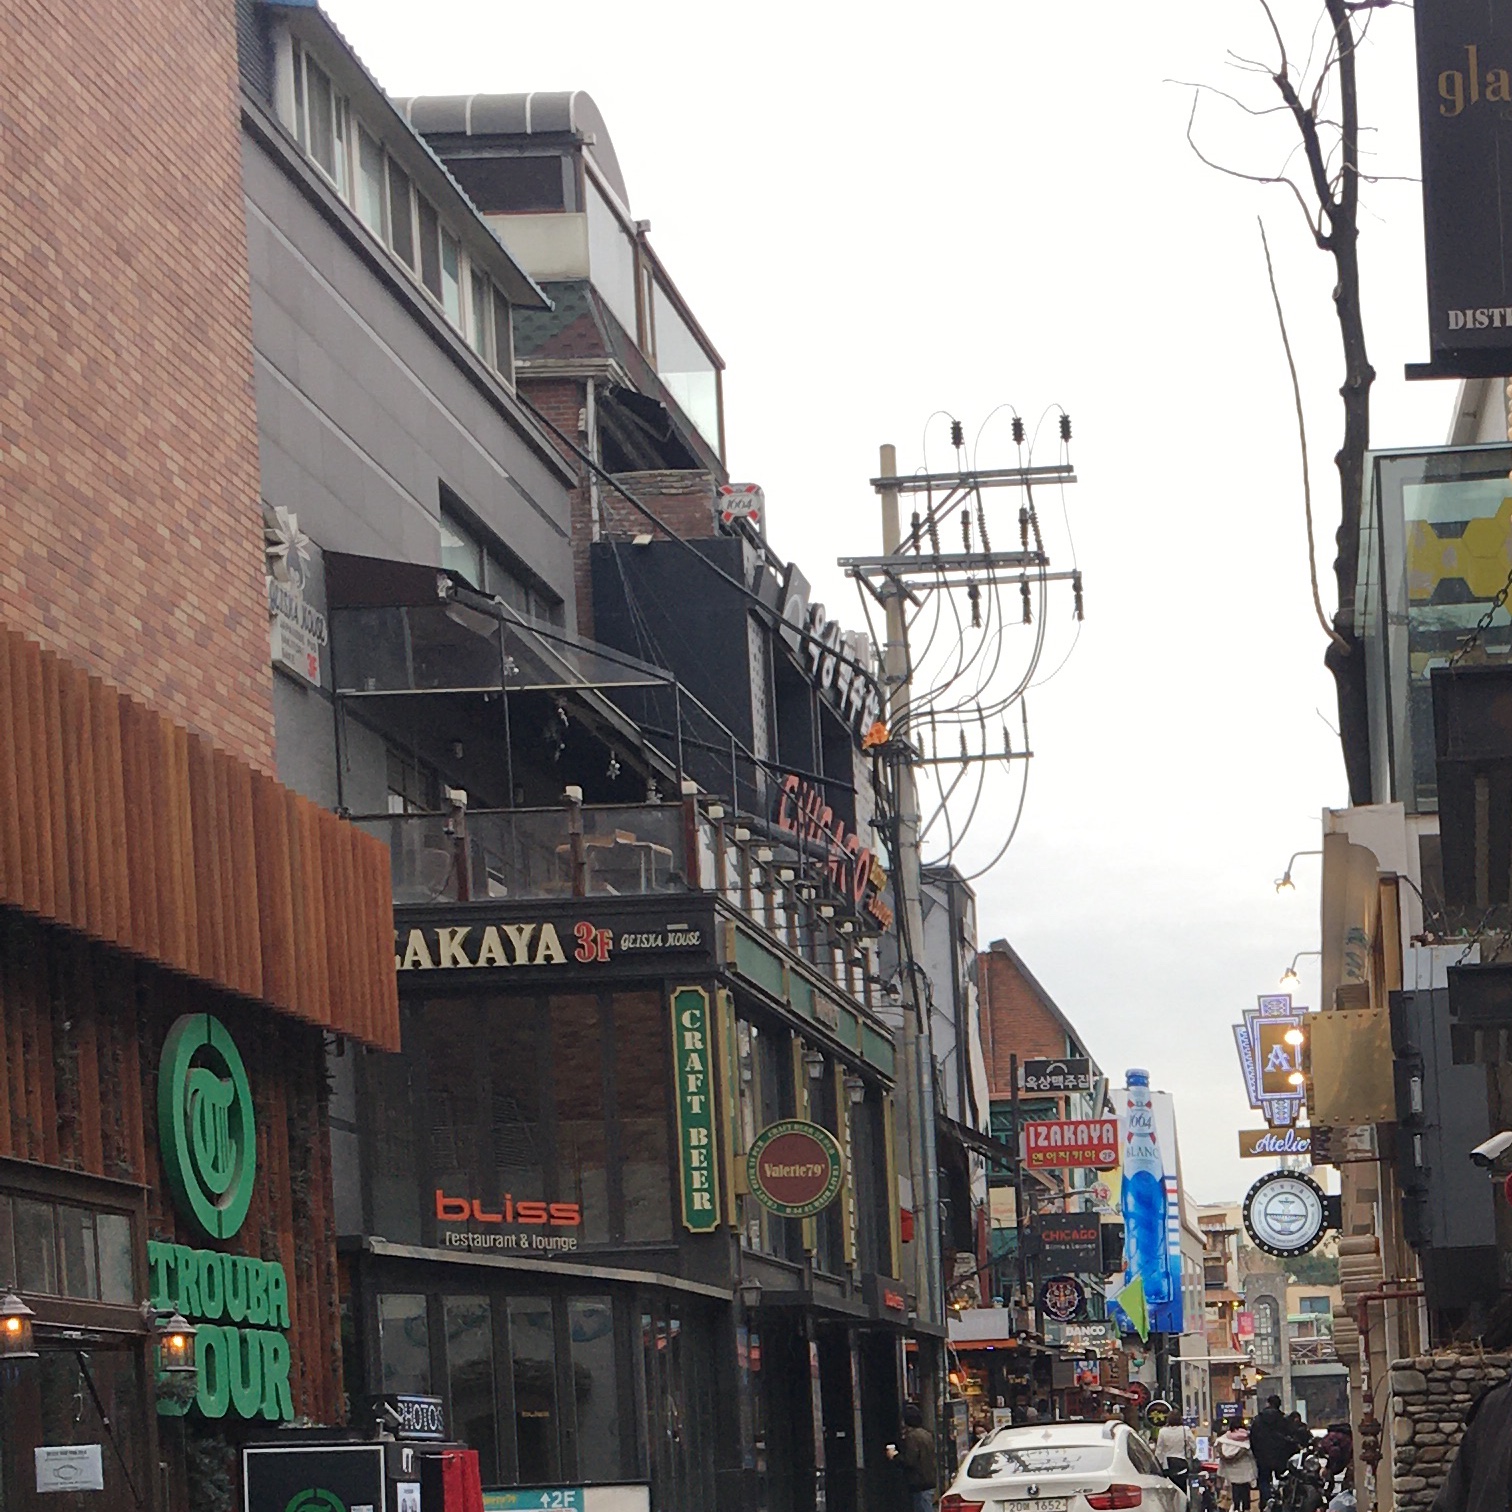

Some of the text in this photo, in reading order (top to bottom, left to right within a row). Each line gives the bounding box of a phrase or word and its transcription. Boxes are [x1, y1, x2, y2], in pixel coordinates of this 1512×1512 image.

[395, 921, 568, 971] AKAYA
[574, 920, 613, 963] 3F
[664, 931, 701, 949] HOUSE
[1263, 1043, 1293, 1073] A
[1025, 1073, 1090, 1091] 옥상맥주집
[681, 1009, 713, 1211] CRAFT BEER
[1028, 1122, 1115, 1148] IZAKAYA
[445, 1231, 577, 1251] restaurant & lounge
[1041, 1229, 1097, 1242] CHICAGO
[146, 1240, 291, 1329] TROUBA
[156, 1323, 295, 1421] OUR
[551, 1490, 576, 1508] 2F
